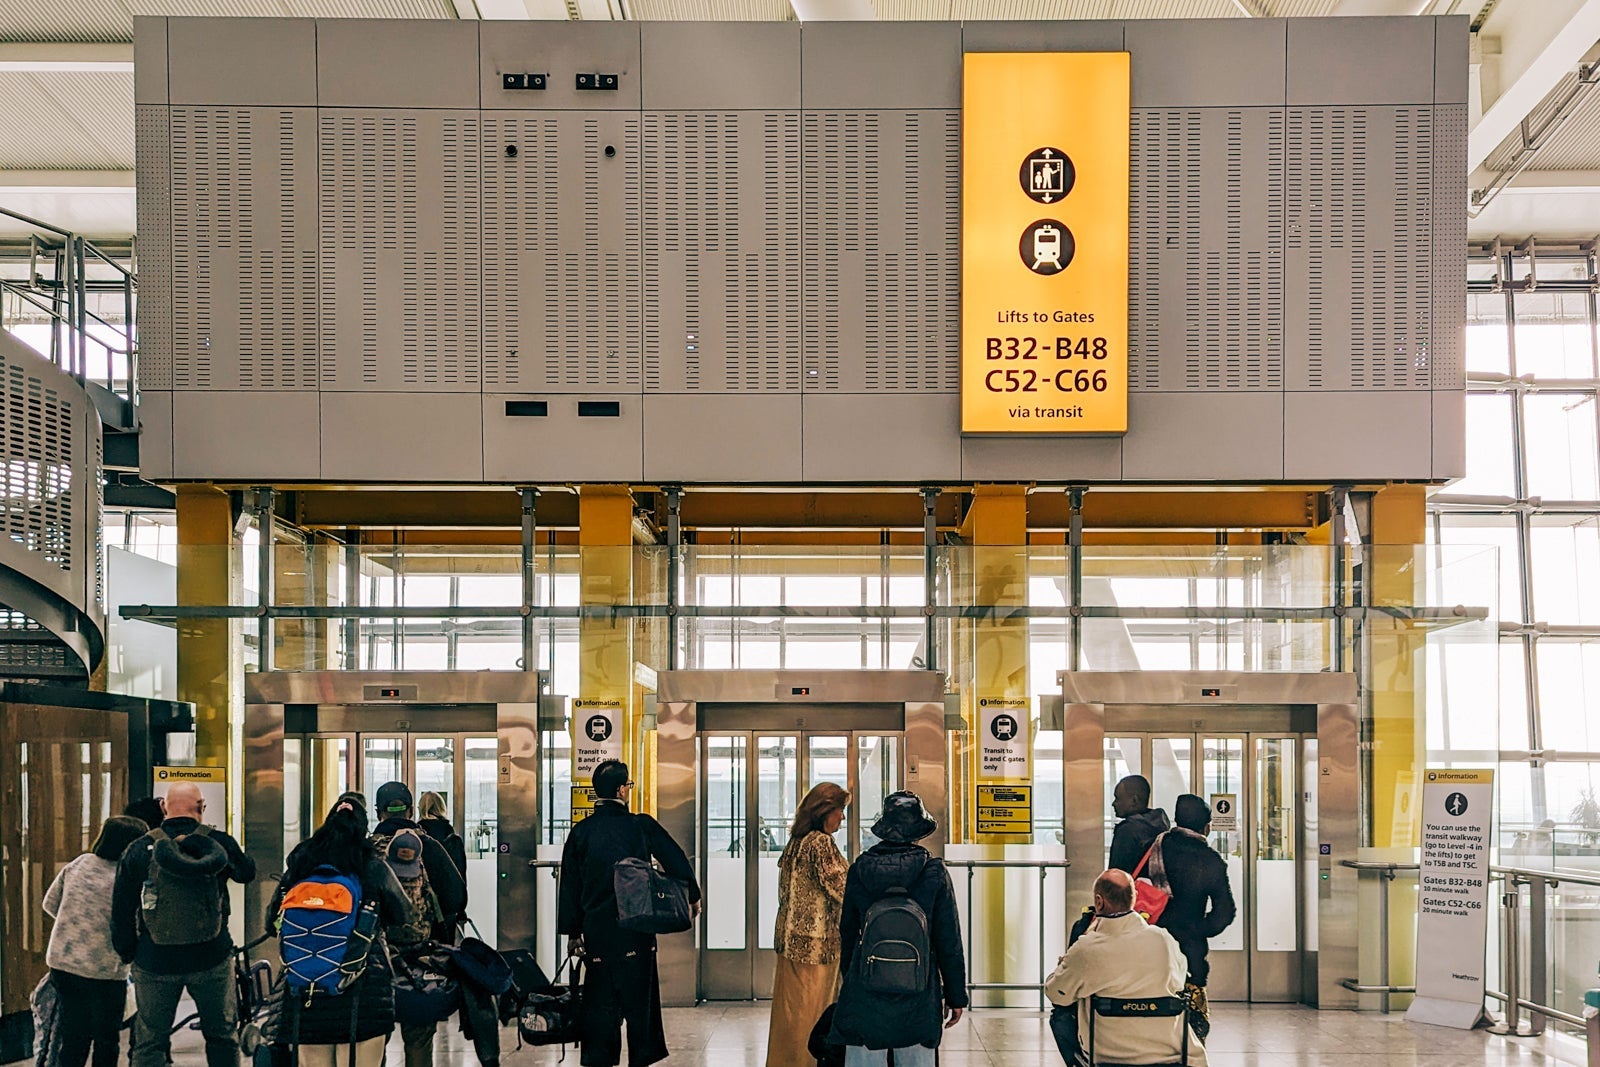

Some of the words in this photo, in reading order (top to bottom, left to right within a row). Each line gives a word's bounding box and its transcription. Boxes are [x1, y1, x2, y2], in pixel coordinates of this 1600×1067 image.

[998, 311, 1029, 323] Lifts
[1033, 312, 1049, 323] to
[1053, 311, 1095, 323] Gates
[1009, 406, 1030, 418] via
[1035, 406, 1083, 418] transit
[1449, 834, 1482, 843] walkway
[1425, 842, 1437, 850] (go
[1437, 851, 1453, 860] lifts)
[1424, 876, 1447, 885] Gates
[1448, 877, 1483, 887] B32-B48
[1423, 897, 1446, 907] Gates
[1447, 899, 1481, 909] C52-C66
[1452, 973, 1479, 982] Heathrow
